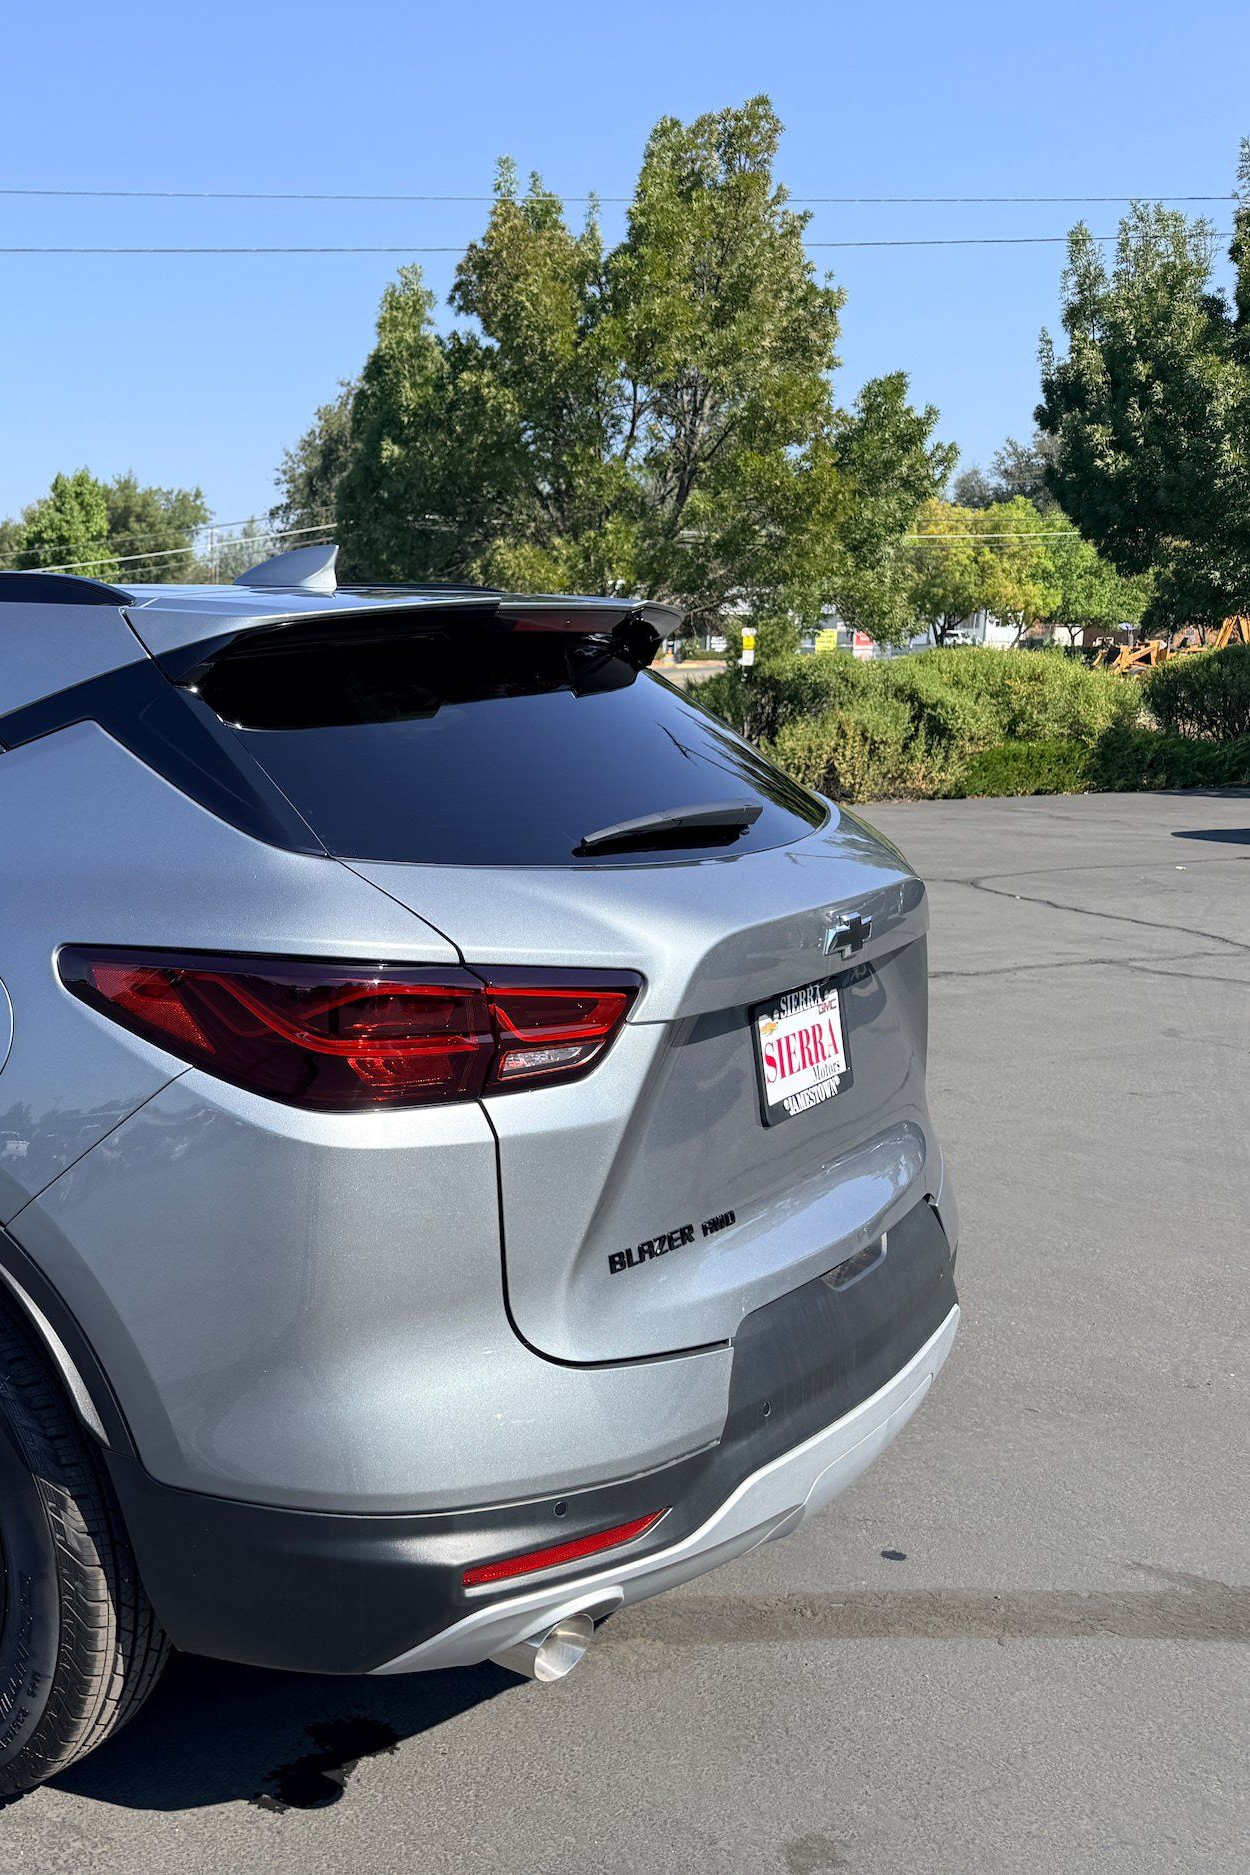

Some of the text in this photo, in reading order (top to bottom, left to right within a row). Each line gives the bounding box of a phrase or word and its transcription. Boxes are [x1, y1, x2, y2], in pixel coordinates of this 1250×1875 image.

[780, 984, 822, 1019] SIERRA
[817, 998, 838, 1015] GMC
[764, 1018, 840, 1084] SIERRA
[813, 1060, 841, 1082] Motors
[787, 1079, 839, 1116] JAMESTOWN
[701, 1210, 737, 1238] AWD
[608, 1224, 696, 1275] BLAZER
